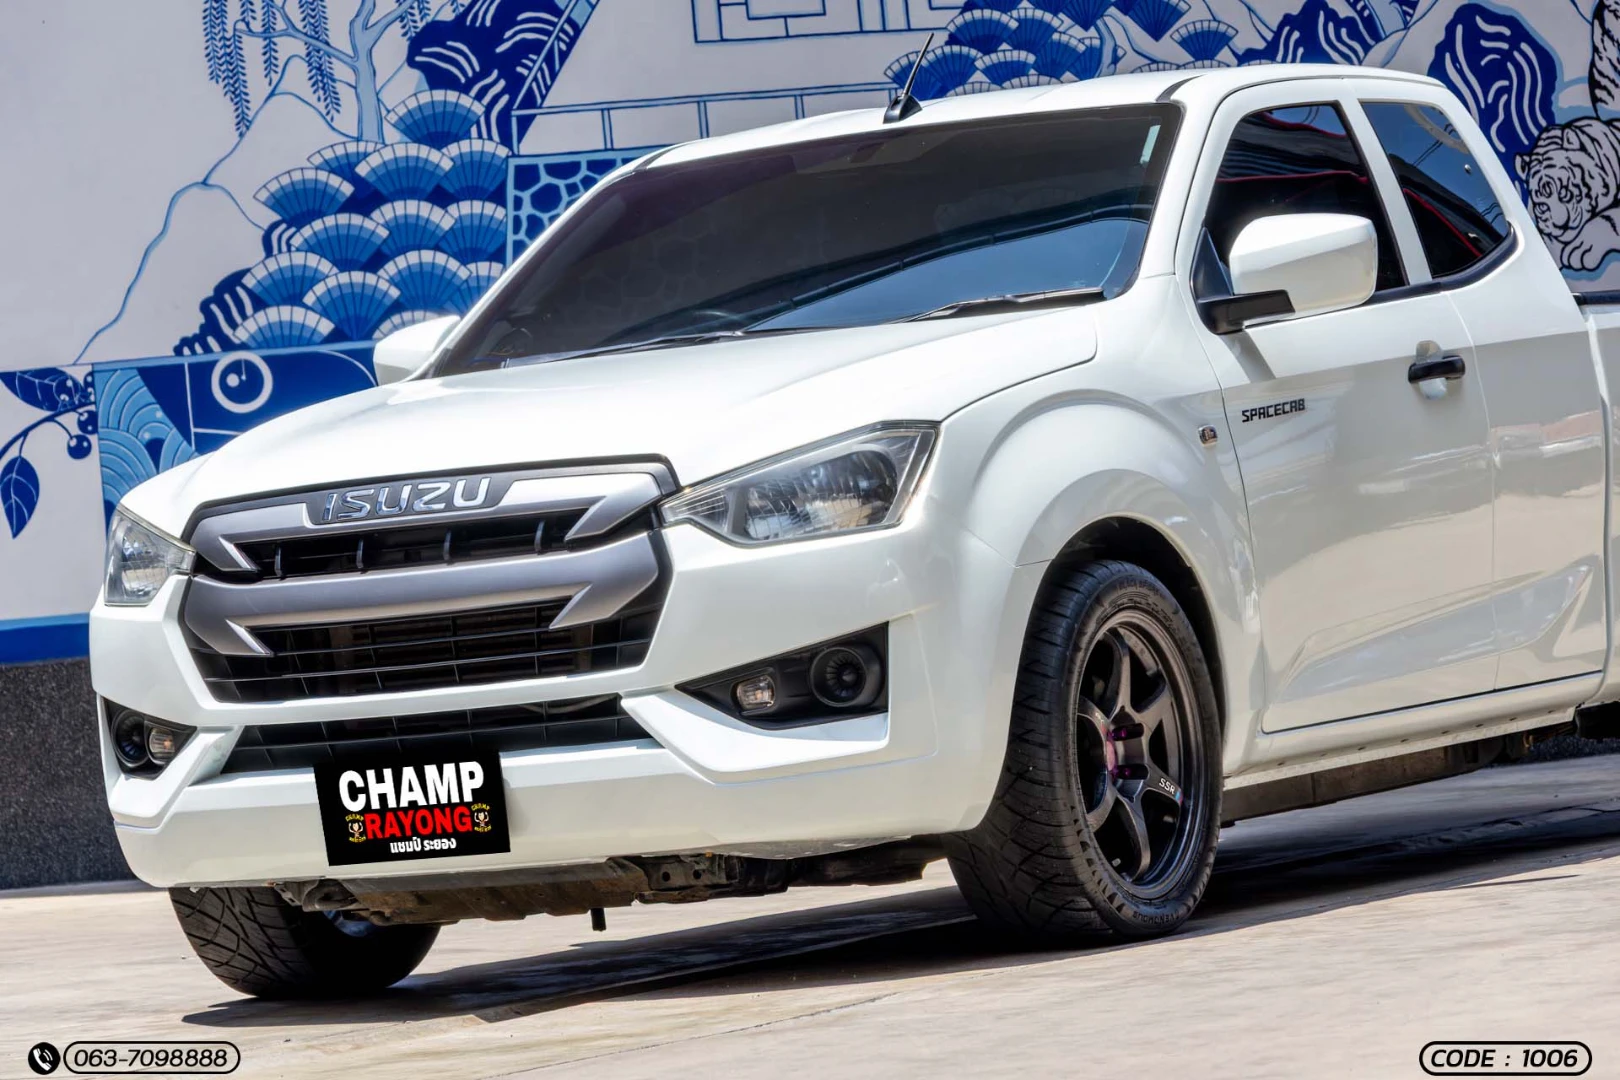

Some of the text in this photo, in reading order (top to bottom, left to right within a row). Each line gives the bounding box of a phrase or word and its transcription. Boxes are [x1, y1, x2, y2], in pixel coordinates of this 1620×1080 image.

[1241, 398, 1306, 423] SPACECAB
[322, 477, 492, 521] ISUZU
[1158, 777, 1176, 795] SSR
